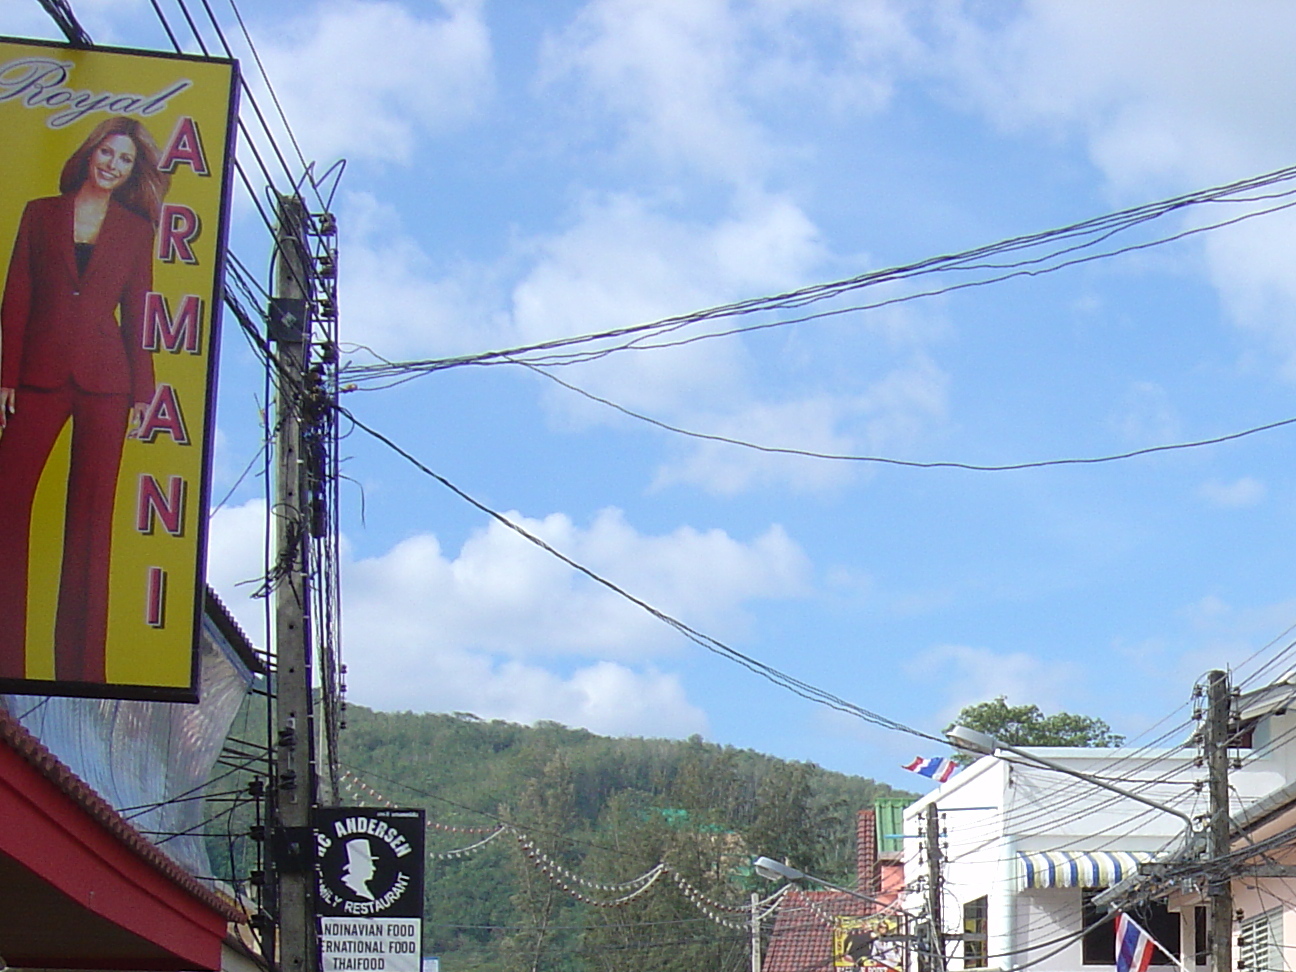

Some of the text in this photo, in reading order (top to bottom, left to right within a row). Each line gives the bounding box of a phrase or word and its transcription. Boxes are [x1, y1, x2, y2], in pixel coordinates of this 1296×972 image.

[0, 59, 191, 128] Royal
[138, 117, 210, 627] ARMANI
[334, 816, 412, 858] ANDERSEN
[343, 871, 410, 915] RESTAURANT
[321, 940, 416, 954] ERNATIONAL FOOD
[324, 923, 415, 937] NDINAVIAN FOOD
[333, 957, 385, 970] THAIFOOD
